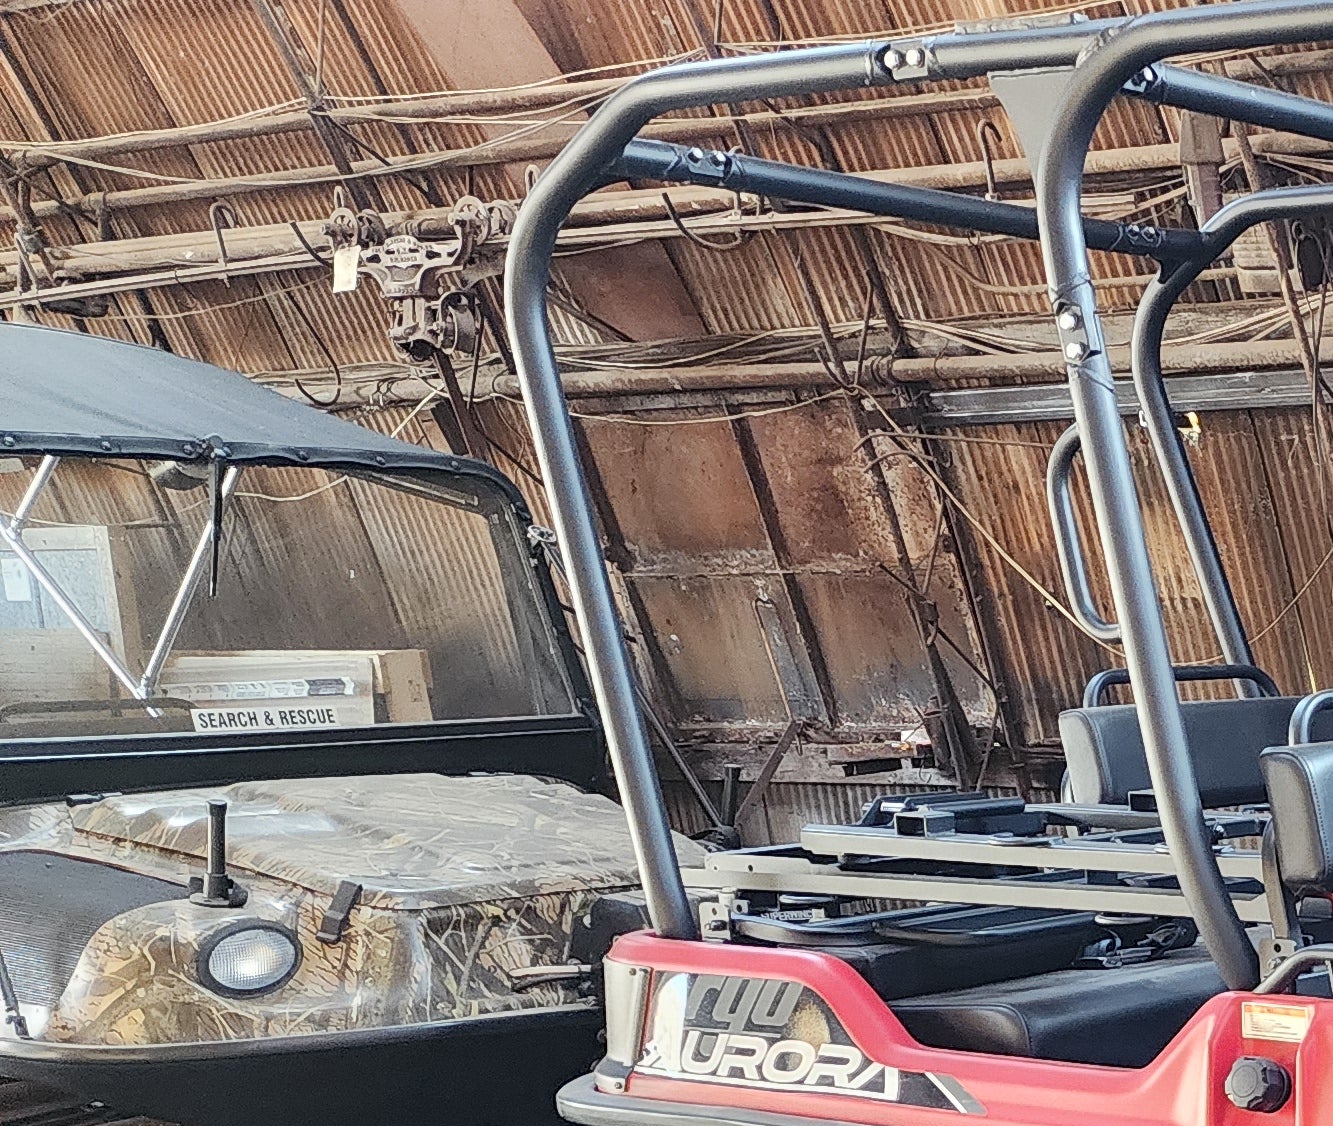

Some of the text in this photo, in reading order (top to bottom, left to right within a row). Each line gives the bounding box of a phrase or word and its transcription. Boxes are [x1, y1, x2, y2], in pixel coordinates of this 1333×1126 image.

[197, 708, 336, 729] SEARCH & RESCUE
